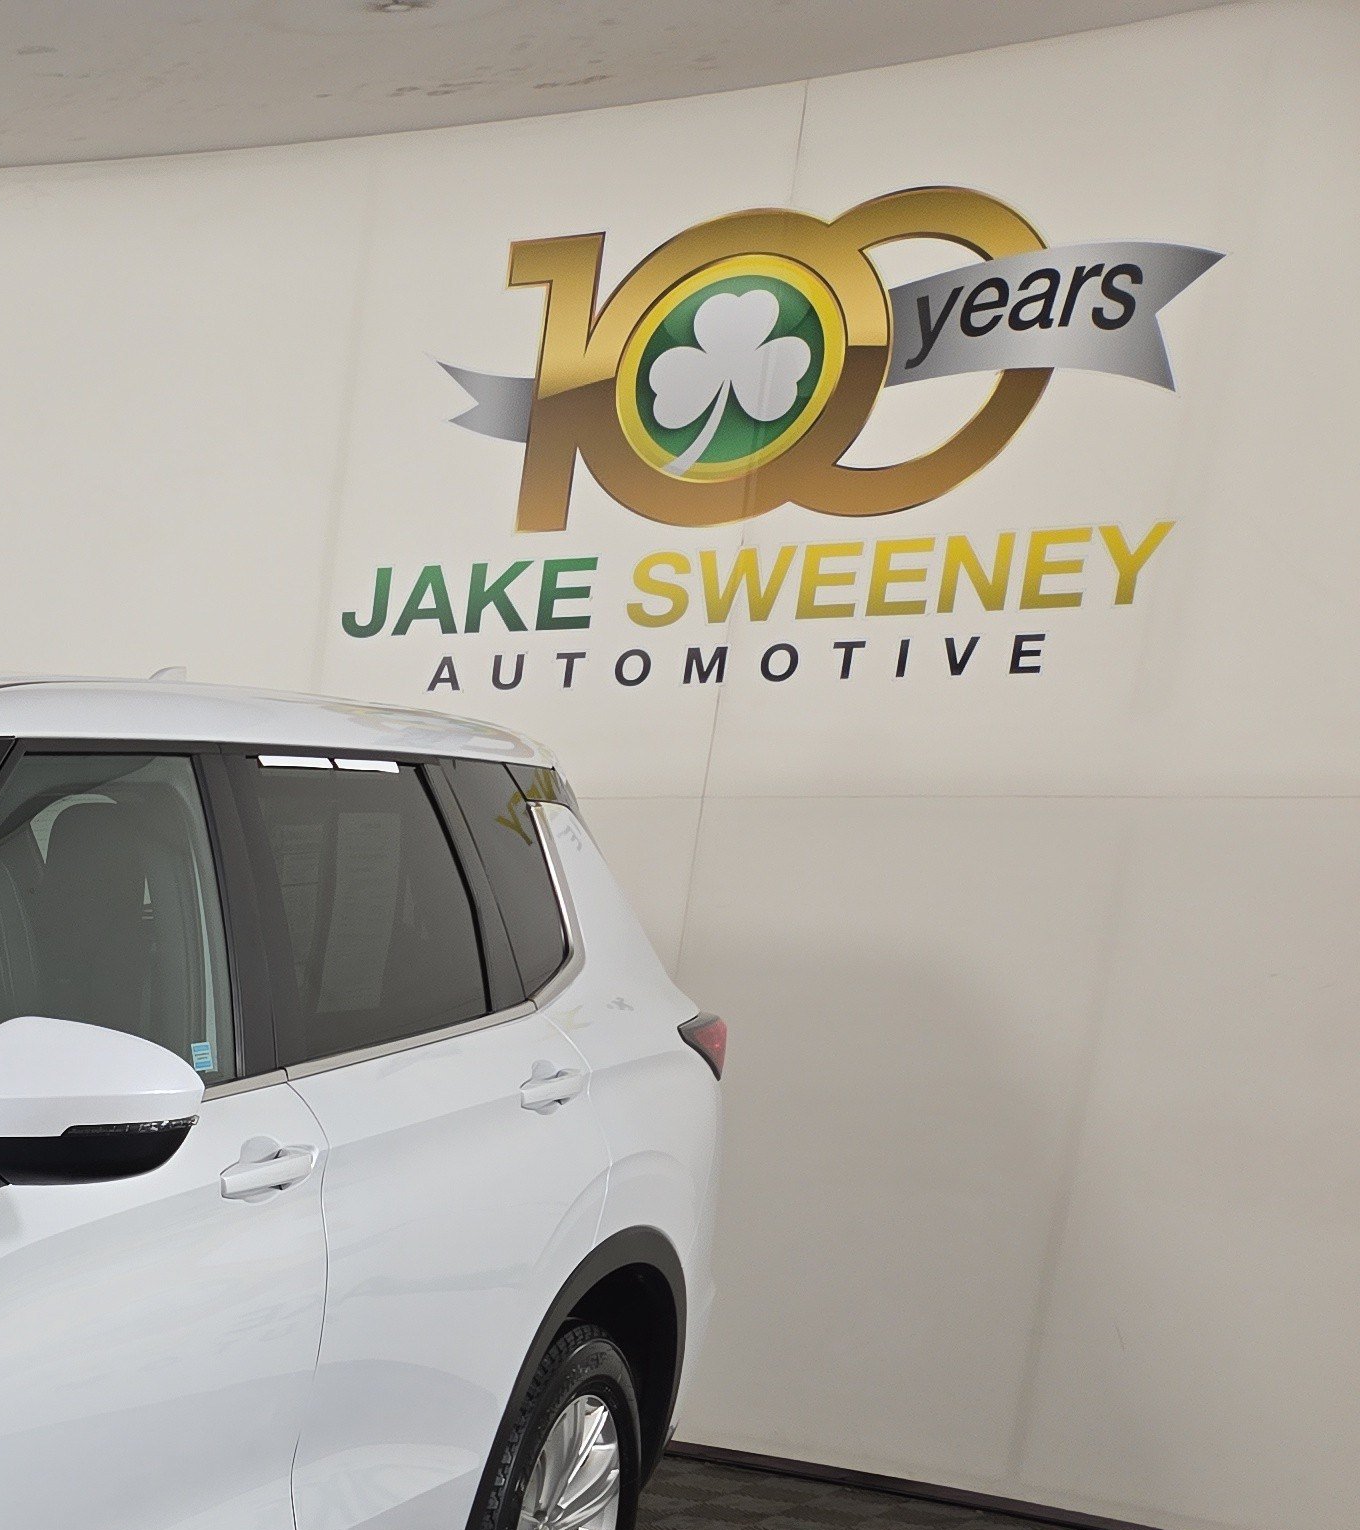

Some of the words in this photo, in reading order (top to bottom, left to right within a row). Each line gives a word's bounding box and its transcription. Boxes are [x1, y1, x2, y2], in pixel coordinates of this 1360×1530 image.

[904, 256, 1144, 370] years
[341, 556, 599, 639] JAKE
[625, 521, 1176, 628] SWEENEY
[426, 632, 1048, 692] AUTOMOTIVE
